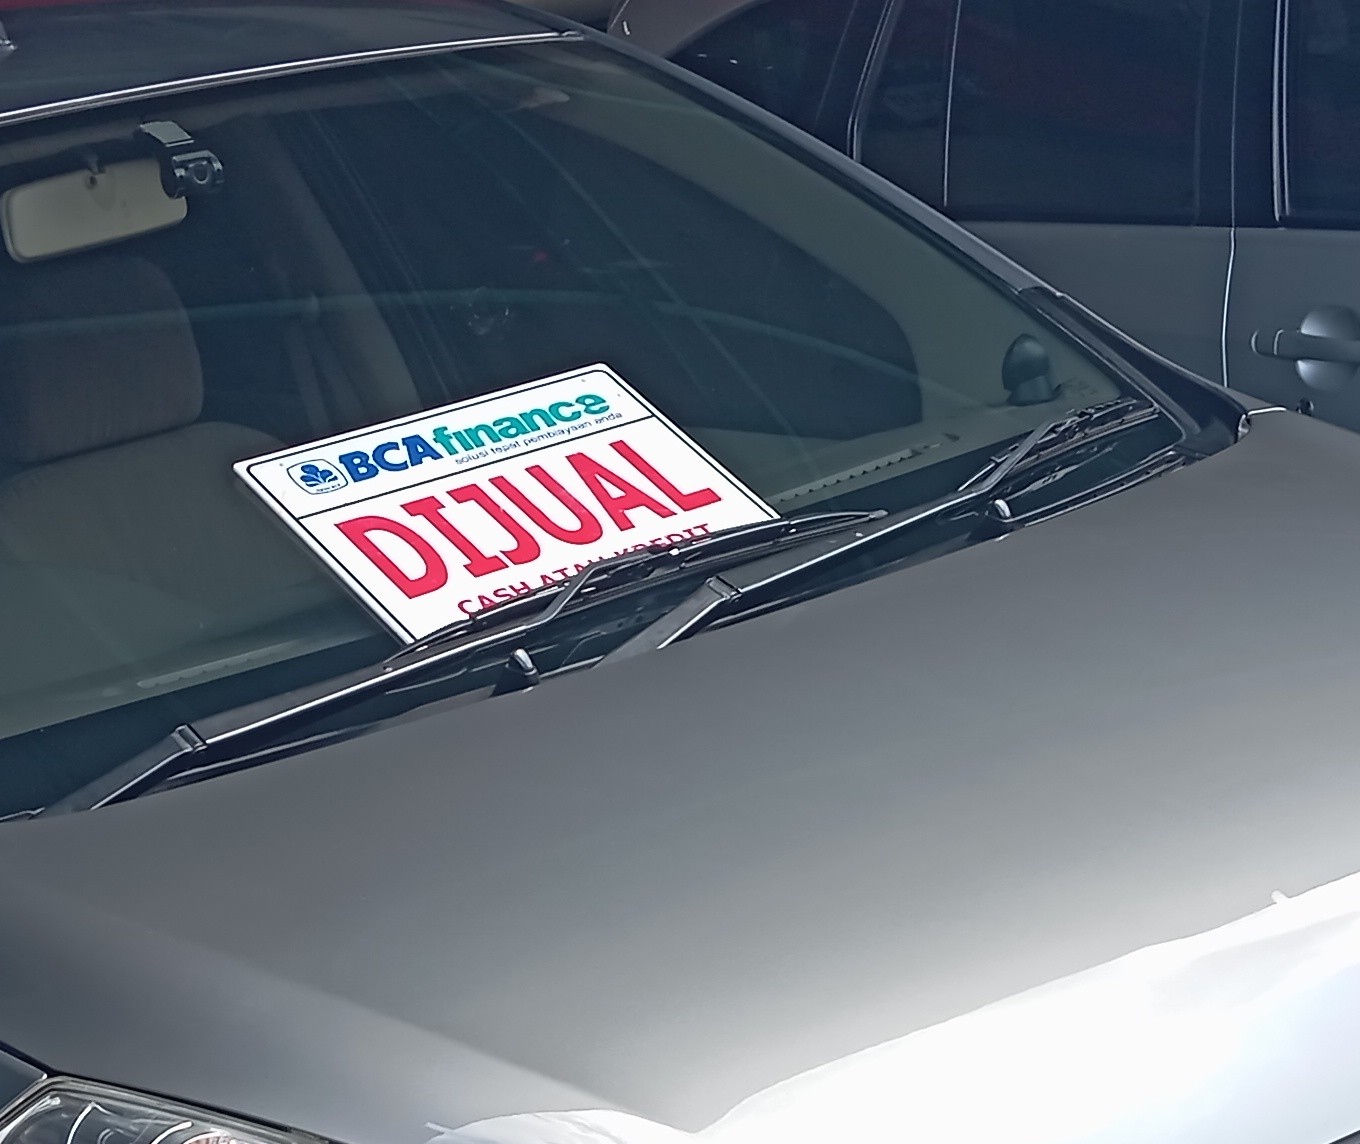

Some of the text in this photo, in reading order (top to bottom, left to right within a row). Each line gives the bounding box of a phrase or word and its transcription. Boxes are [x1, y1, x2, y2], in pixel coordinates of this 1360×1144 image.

[455, 449, 490, 466] solusi
[594, 412, 623, 427] anda
[333, 439, 723, 600] DIJUAL
